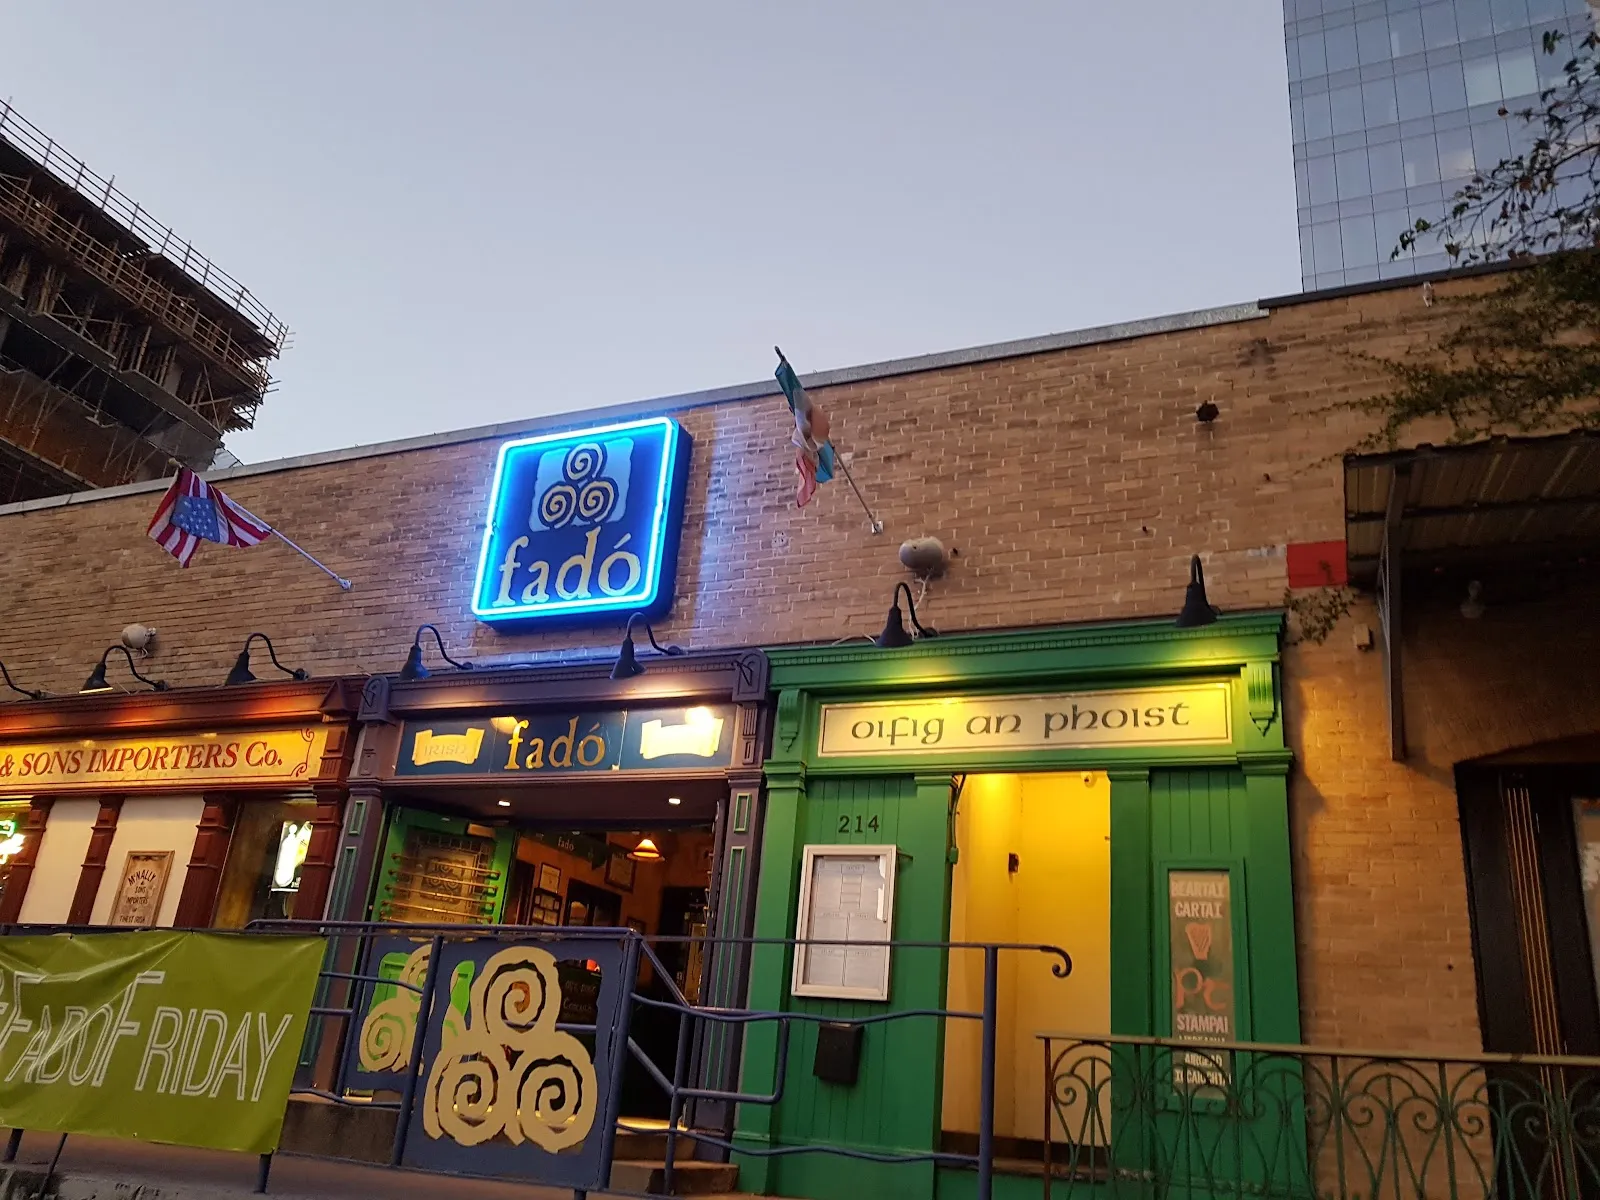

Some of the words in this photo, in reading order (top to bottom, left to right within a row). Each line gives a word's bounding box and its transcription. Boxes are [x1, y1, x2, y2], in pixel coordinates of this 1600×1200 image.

[492, 526, 641, 608] fadó
[504, 715, 606, 770] fadó
[851, 715, 945, 746] oifig
[966, 712, 1022, 736] an
[1044, 702, 1190, 739] phoist
[0, 754, 15, 778] &
[18, 750, 84, 777] SONS
[86, 742, 240, 773] IMPORTERS
[245, 740, 283, 767] Co.
[838, 814, 880, 834] 214
